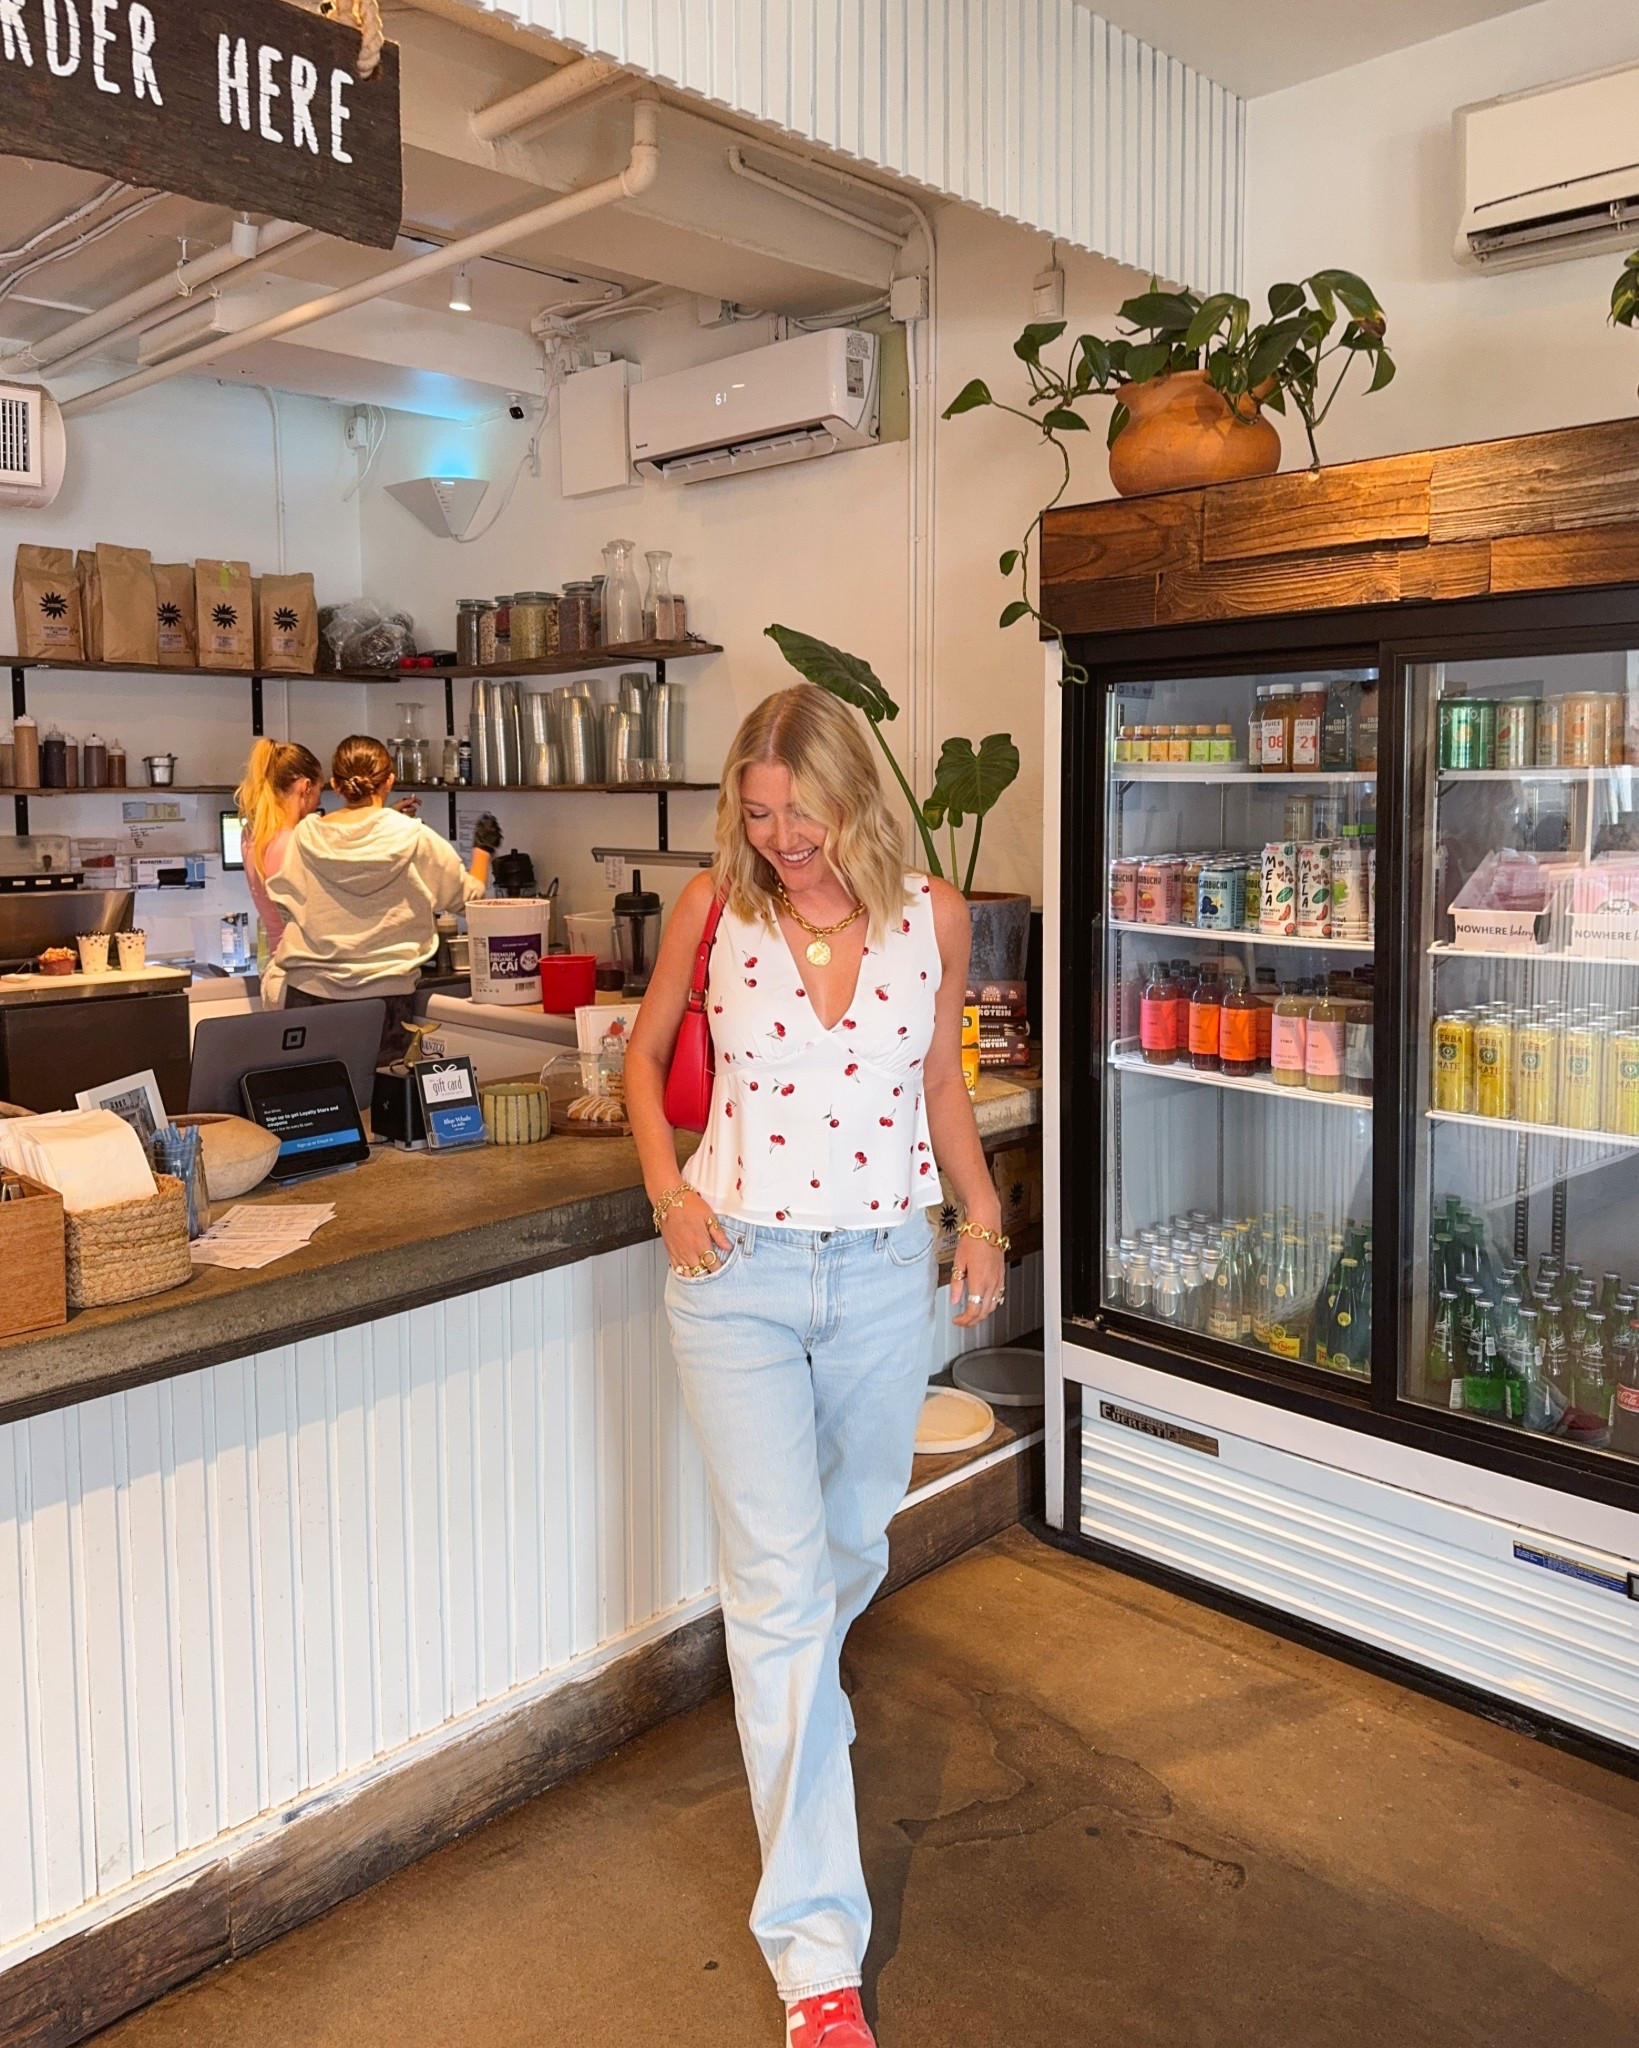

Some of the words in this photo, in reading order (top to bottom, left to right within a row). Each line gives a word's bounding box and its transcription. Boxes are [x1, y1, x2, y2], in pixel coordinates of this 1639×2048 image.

[217, 33, 354, 164] HERE
[1268, 735, 1284, 748] 08
[1300, 735, 1317, 748] 21
[1265, 856, 1276, 906] MELA
[1301, 860, 1312, 908] MELA
[1457, 924, 1508, 935] NOWHERE
[1509, 924, 1534, 941] bakery
[1574, 929, 1632, 941] NOWHERE
[491, 958, 519, 974] AÇAÍ
[1477, 1037, 1503, 1048] ERBA
[433, 1078, 446, 1096] gift
[447, 1076, 463, 1091] card
[299, 1109, 317, 1117] Loyalty
